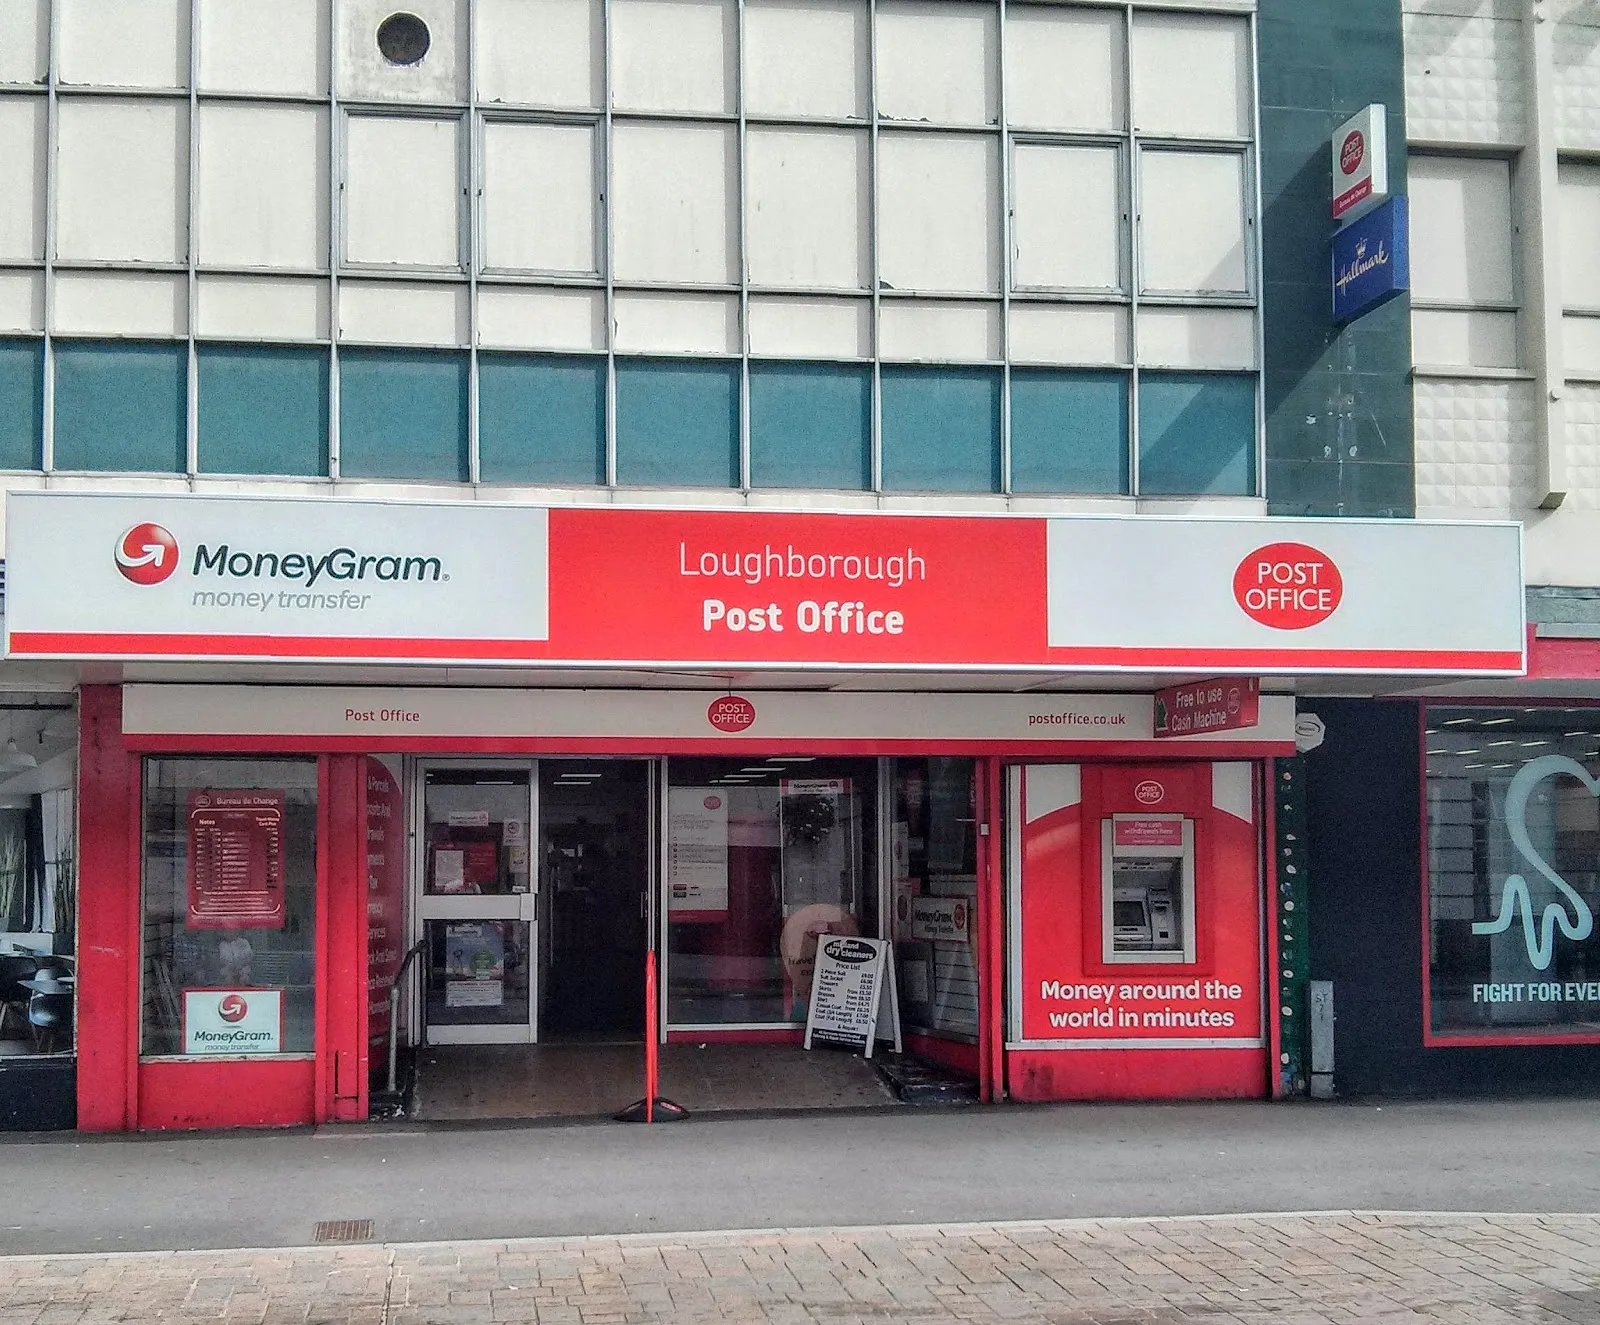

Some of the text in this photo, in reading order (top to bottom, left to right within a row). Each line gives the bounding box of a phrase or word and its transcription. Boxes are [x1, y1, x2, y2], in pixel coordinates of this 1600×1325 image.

[1345, 136, 1360, 155] POST
[1342, 146, 1363, 168] OFFICE
[1336, 240, 1389, 296] Hallmark
[679, 541, 927, 588] Loughborough
[1257, 562, 1324, 585] POST
[192, 589, 372, 613] money transfer
[1245, 588, 1332, 611] OFFICE
[703, 599, 905, 635] Post Office
[718, 703, 747, 714] POST
[1176, 687, 1223, 709] Free to use
[345, 708, 420, 722] Post Office
[711, 713, 750, 724] OFFICE
[1028, 711, 1126, 728] postoffice.co.uk
[1171, 708, 1227, 732] Cash Machine
[217, 797, 242, 805] Bureau
[253, 797, 279, 806] Change
[826, 945, 874, 960] dry cleaners
[1041, 979, 1242, 1004] Money around the
[1473, 982, 1600, 1003] FIGHT FOR EVE
[1049, 1007, 1235, 1028] world in minutes
[194, 1029, 271, 1044] MoneyGram
[204, 1043, 260, 1051] money transfer
